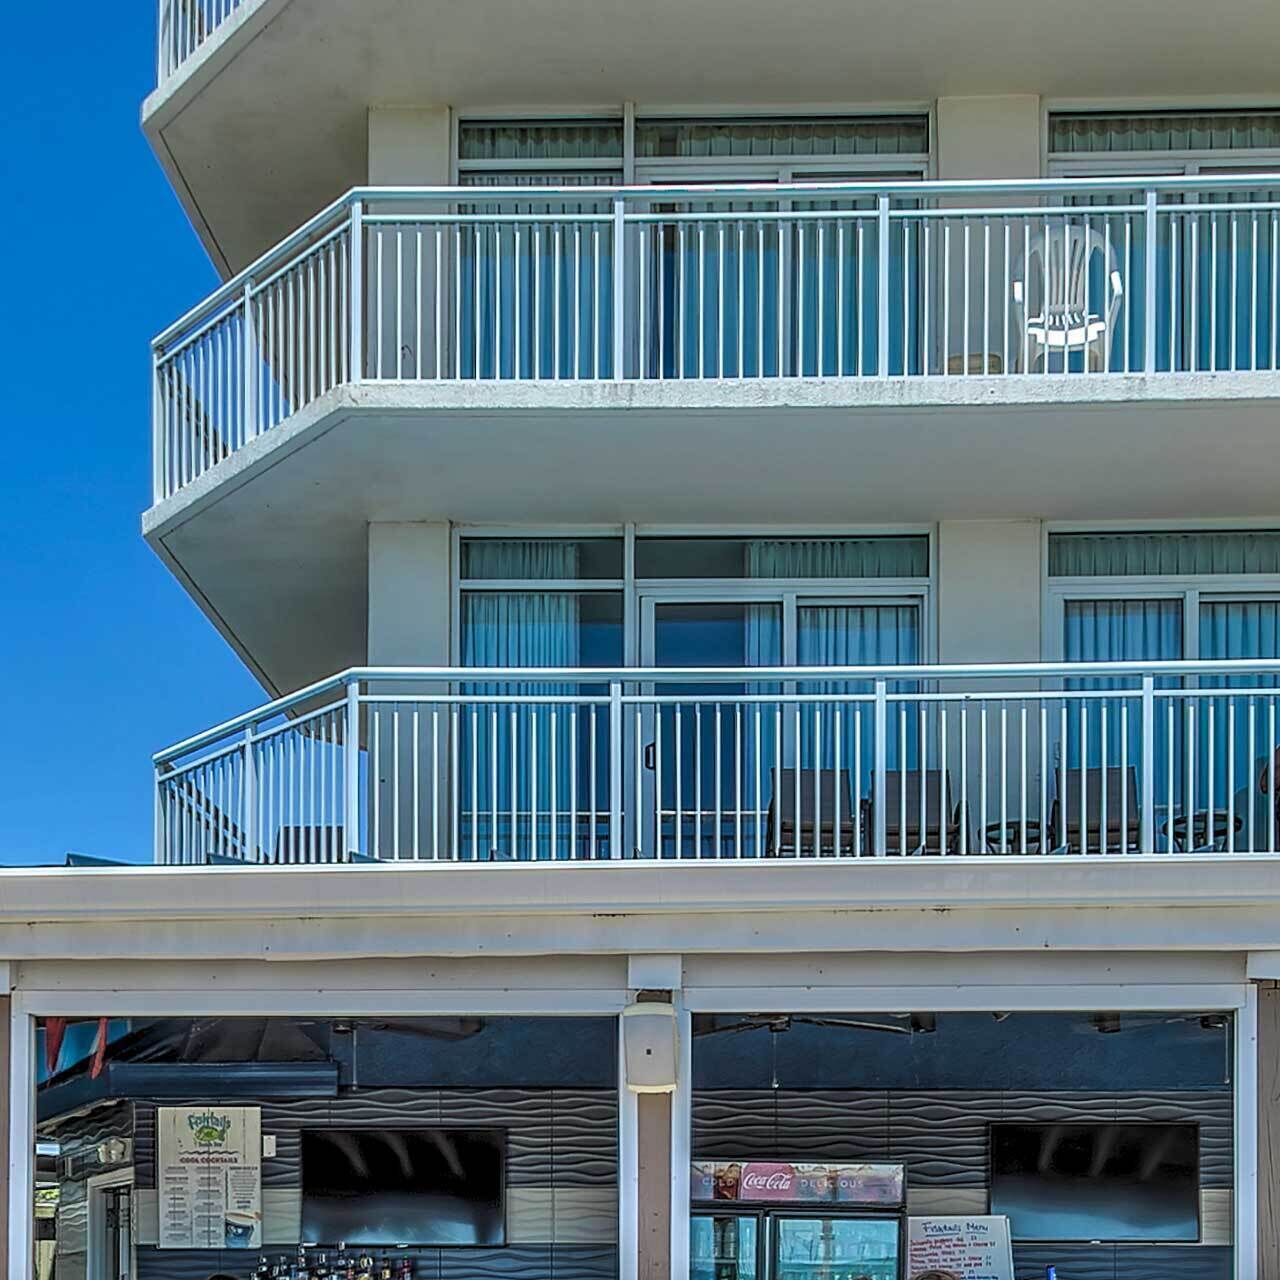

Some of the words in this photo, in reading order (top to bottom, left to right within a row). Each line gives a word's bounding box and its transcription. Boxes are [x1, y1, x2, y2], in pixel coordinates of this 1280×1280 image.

[702, 1178, 734, 1187] COLD
[801, 1178, 863, 1188] DELICOUS
[966, 1223, 988, 1231] Menu
